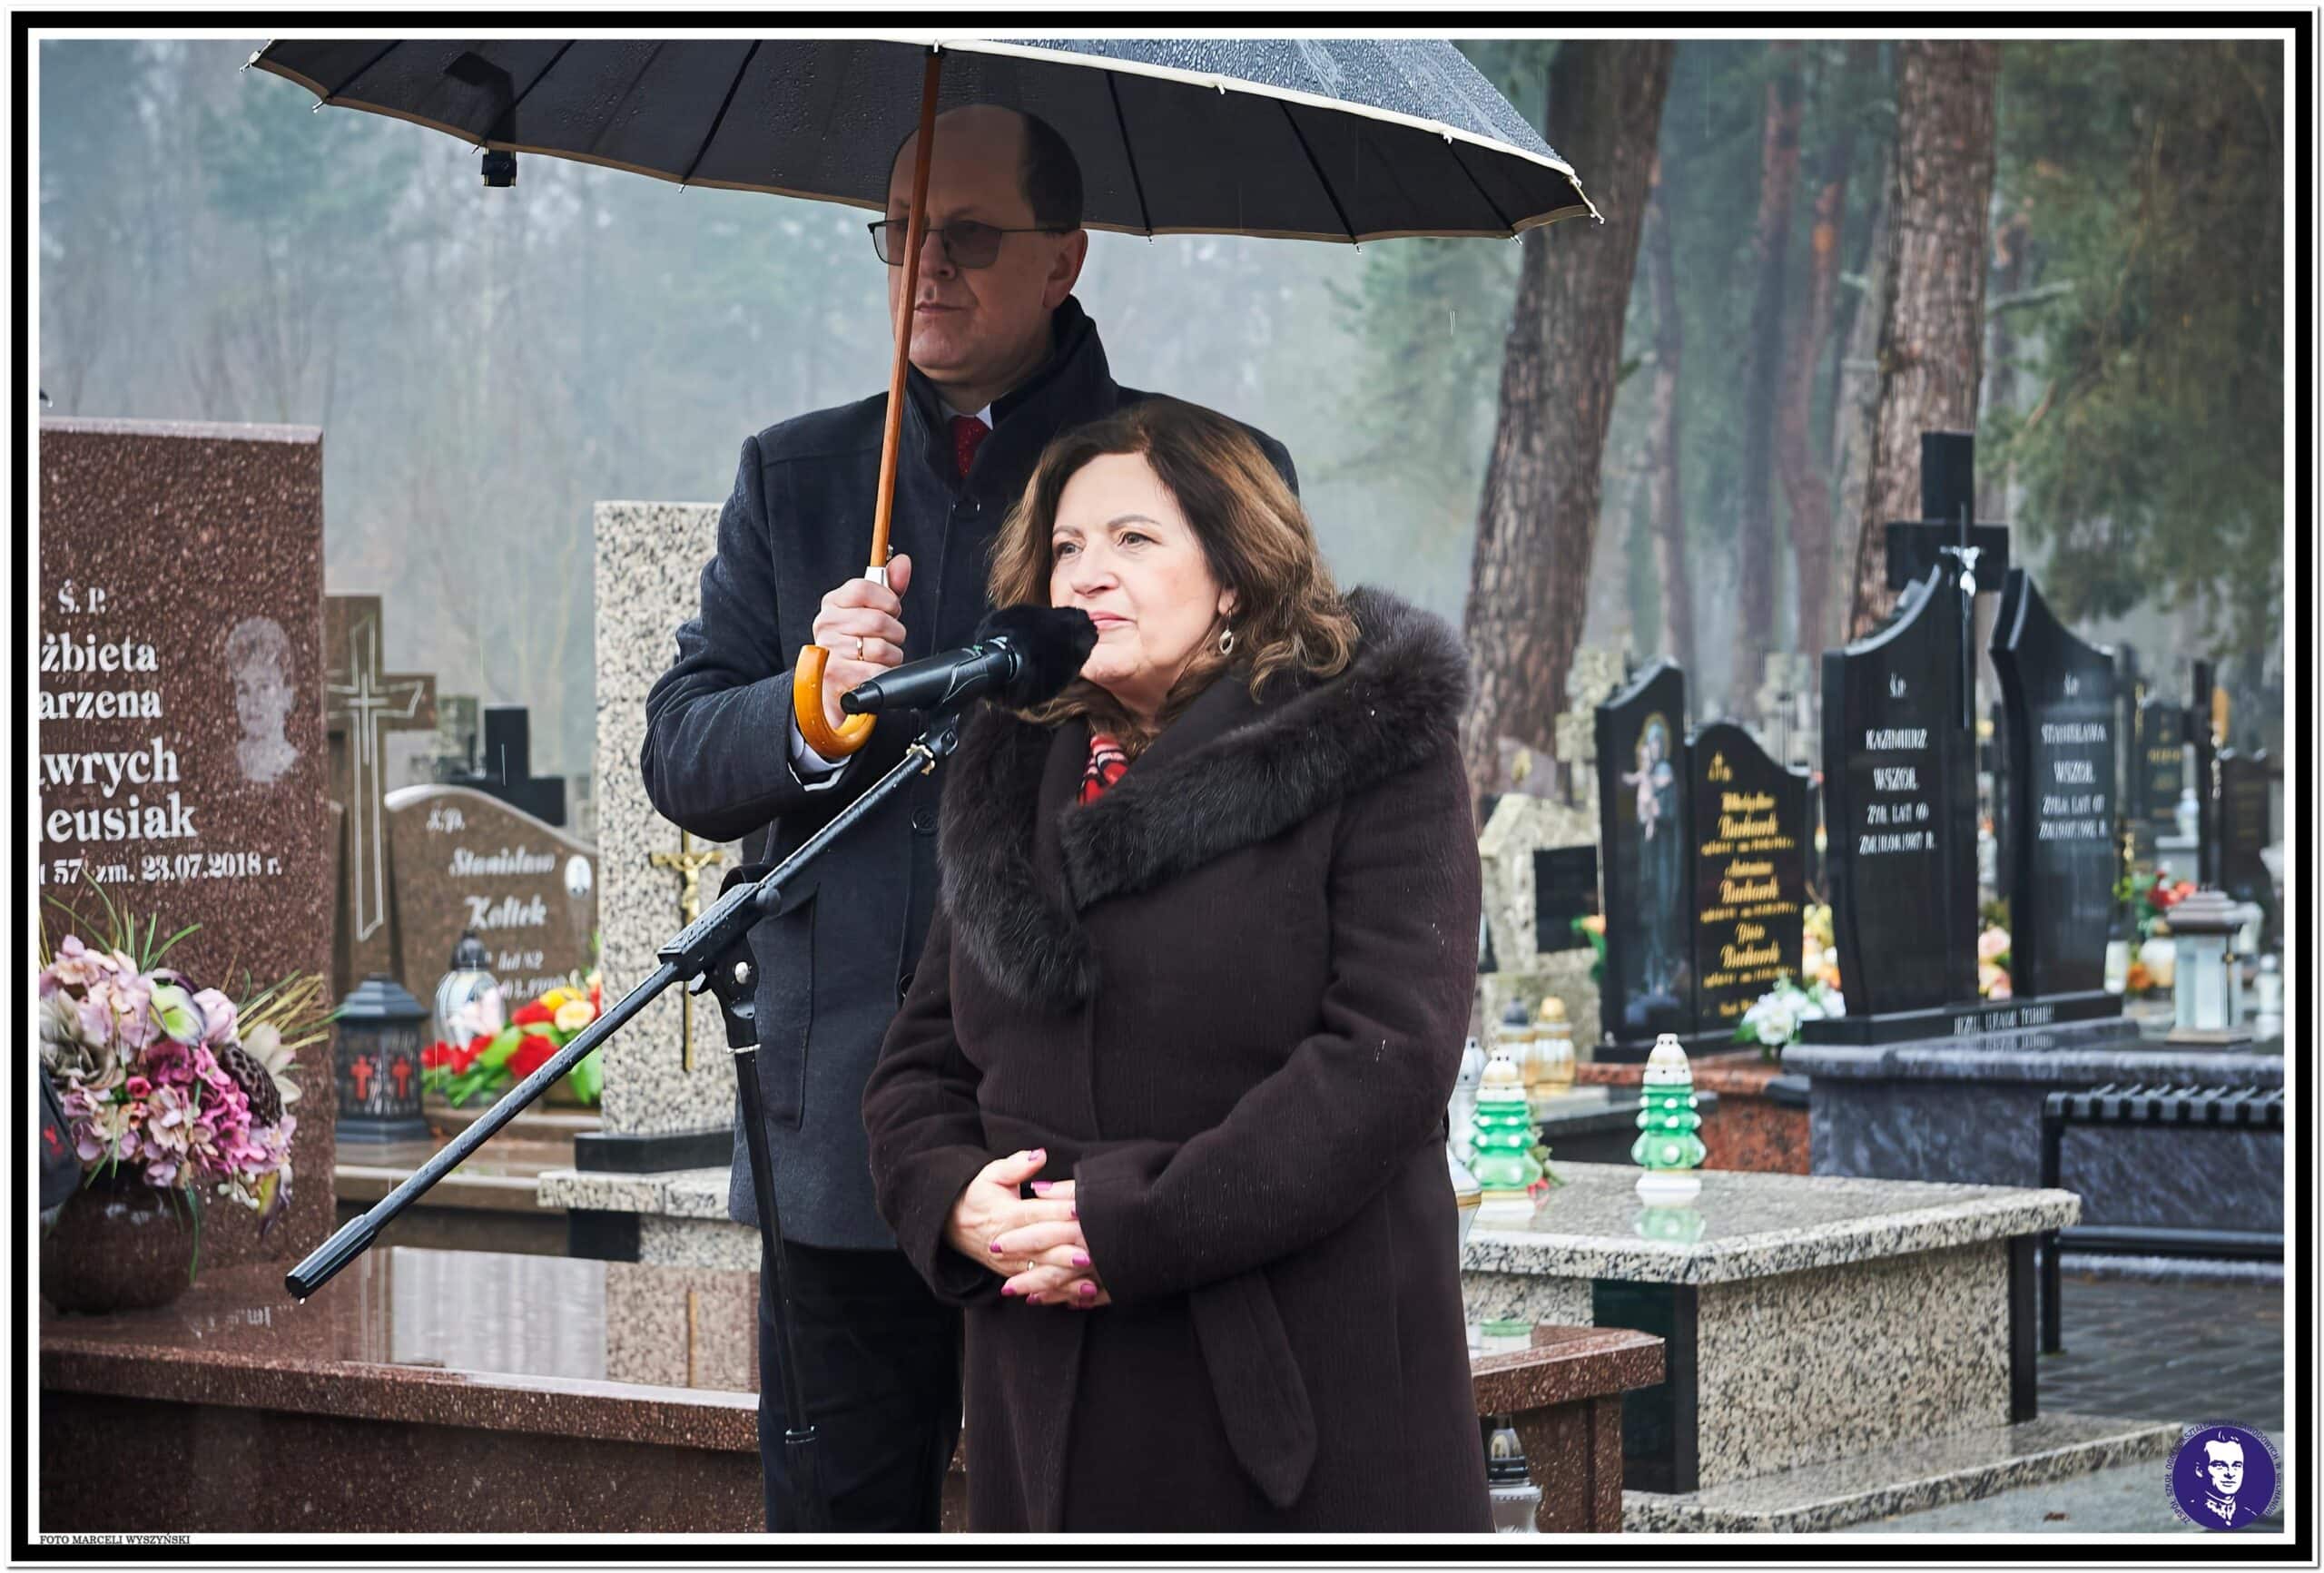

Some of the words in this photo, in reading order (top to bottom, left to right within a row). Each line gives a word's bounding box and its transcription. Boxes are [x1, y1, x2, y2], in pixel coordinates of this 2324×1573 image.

[41, 633, 158, 673] żbieta
[39, 736, 180, 798] wrych
[142, 851, 262, 883] 23.07.2018
